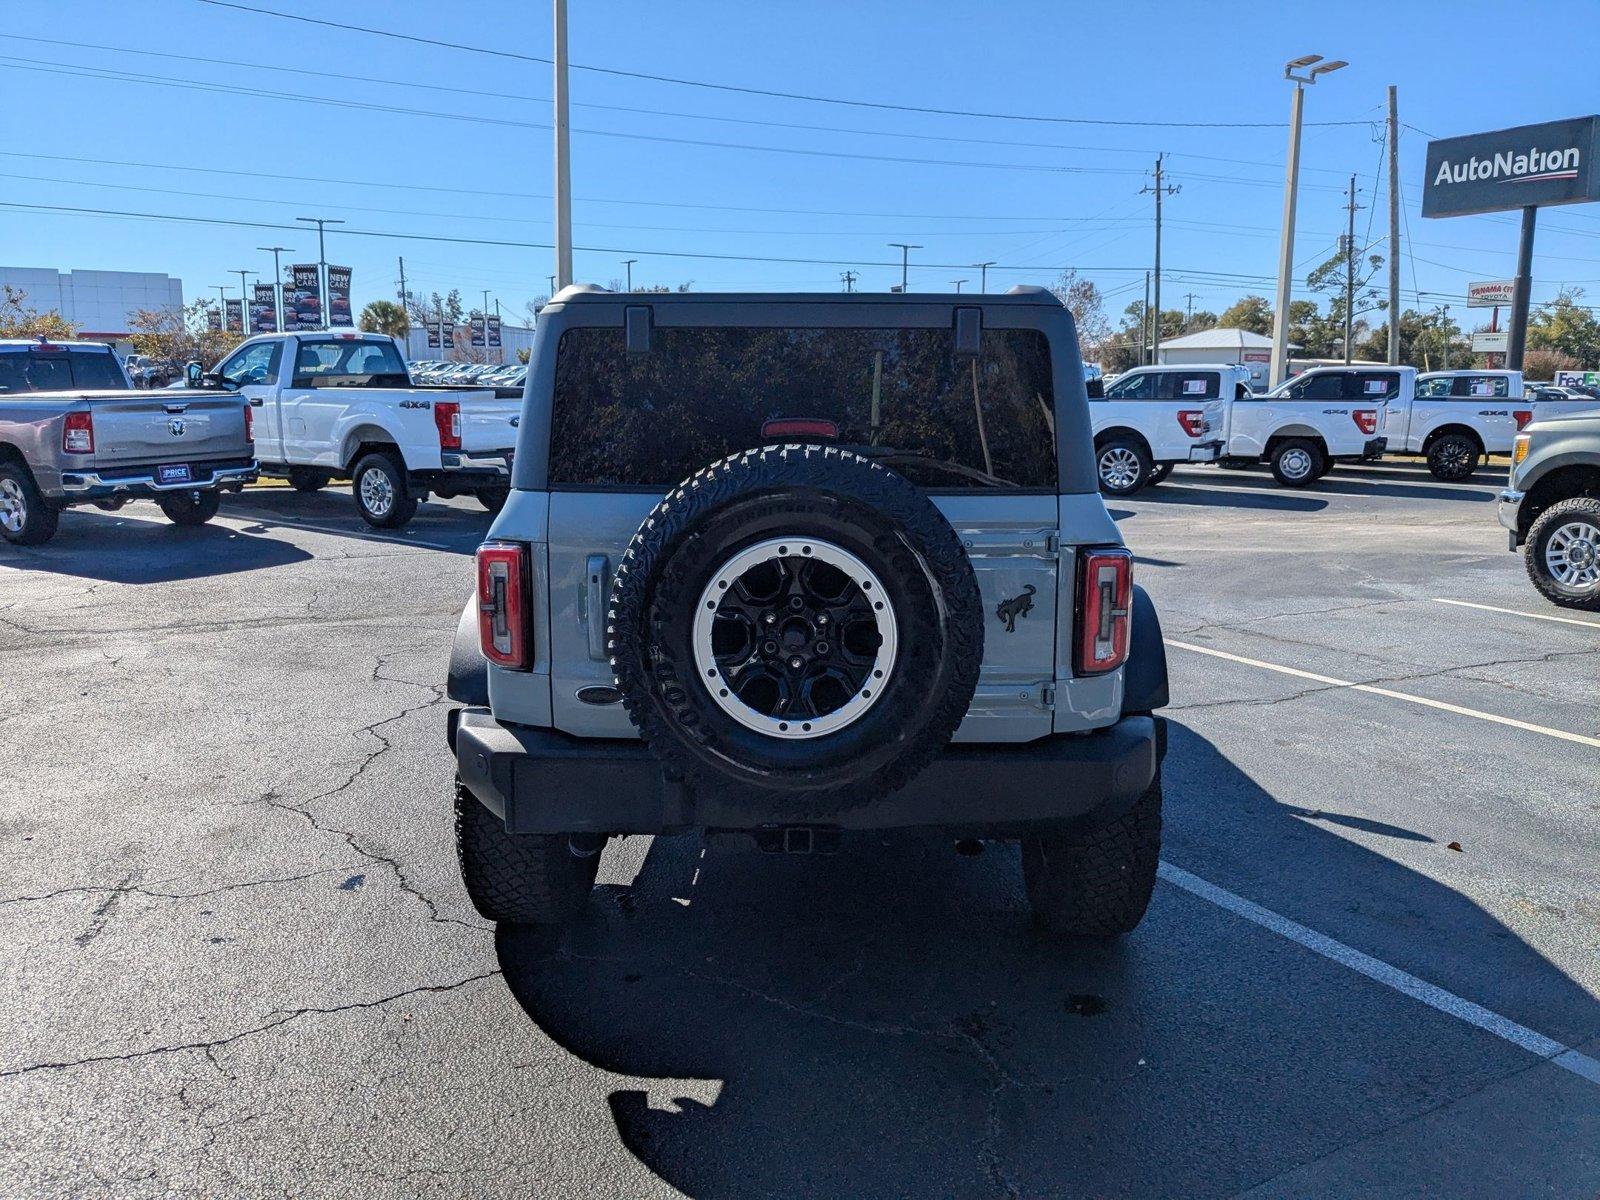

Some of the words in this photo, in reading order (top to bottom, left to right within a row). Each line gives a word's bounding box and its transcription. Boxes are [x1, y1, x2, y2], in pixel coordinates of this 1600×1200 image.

[1434, 147, 1580, 186] AutoNation
[296, 272, 317, 280] NEW
[297, 279, 318, 287] CARS
[329, 281, 349, 289] CARS
[1471, 285, 1502, 297] PANAMA
